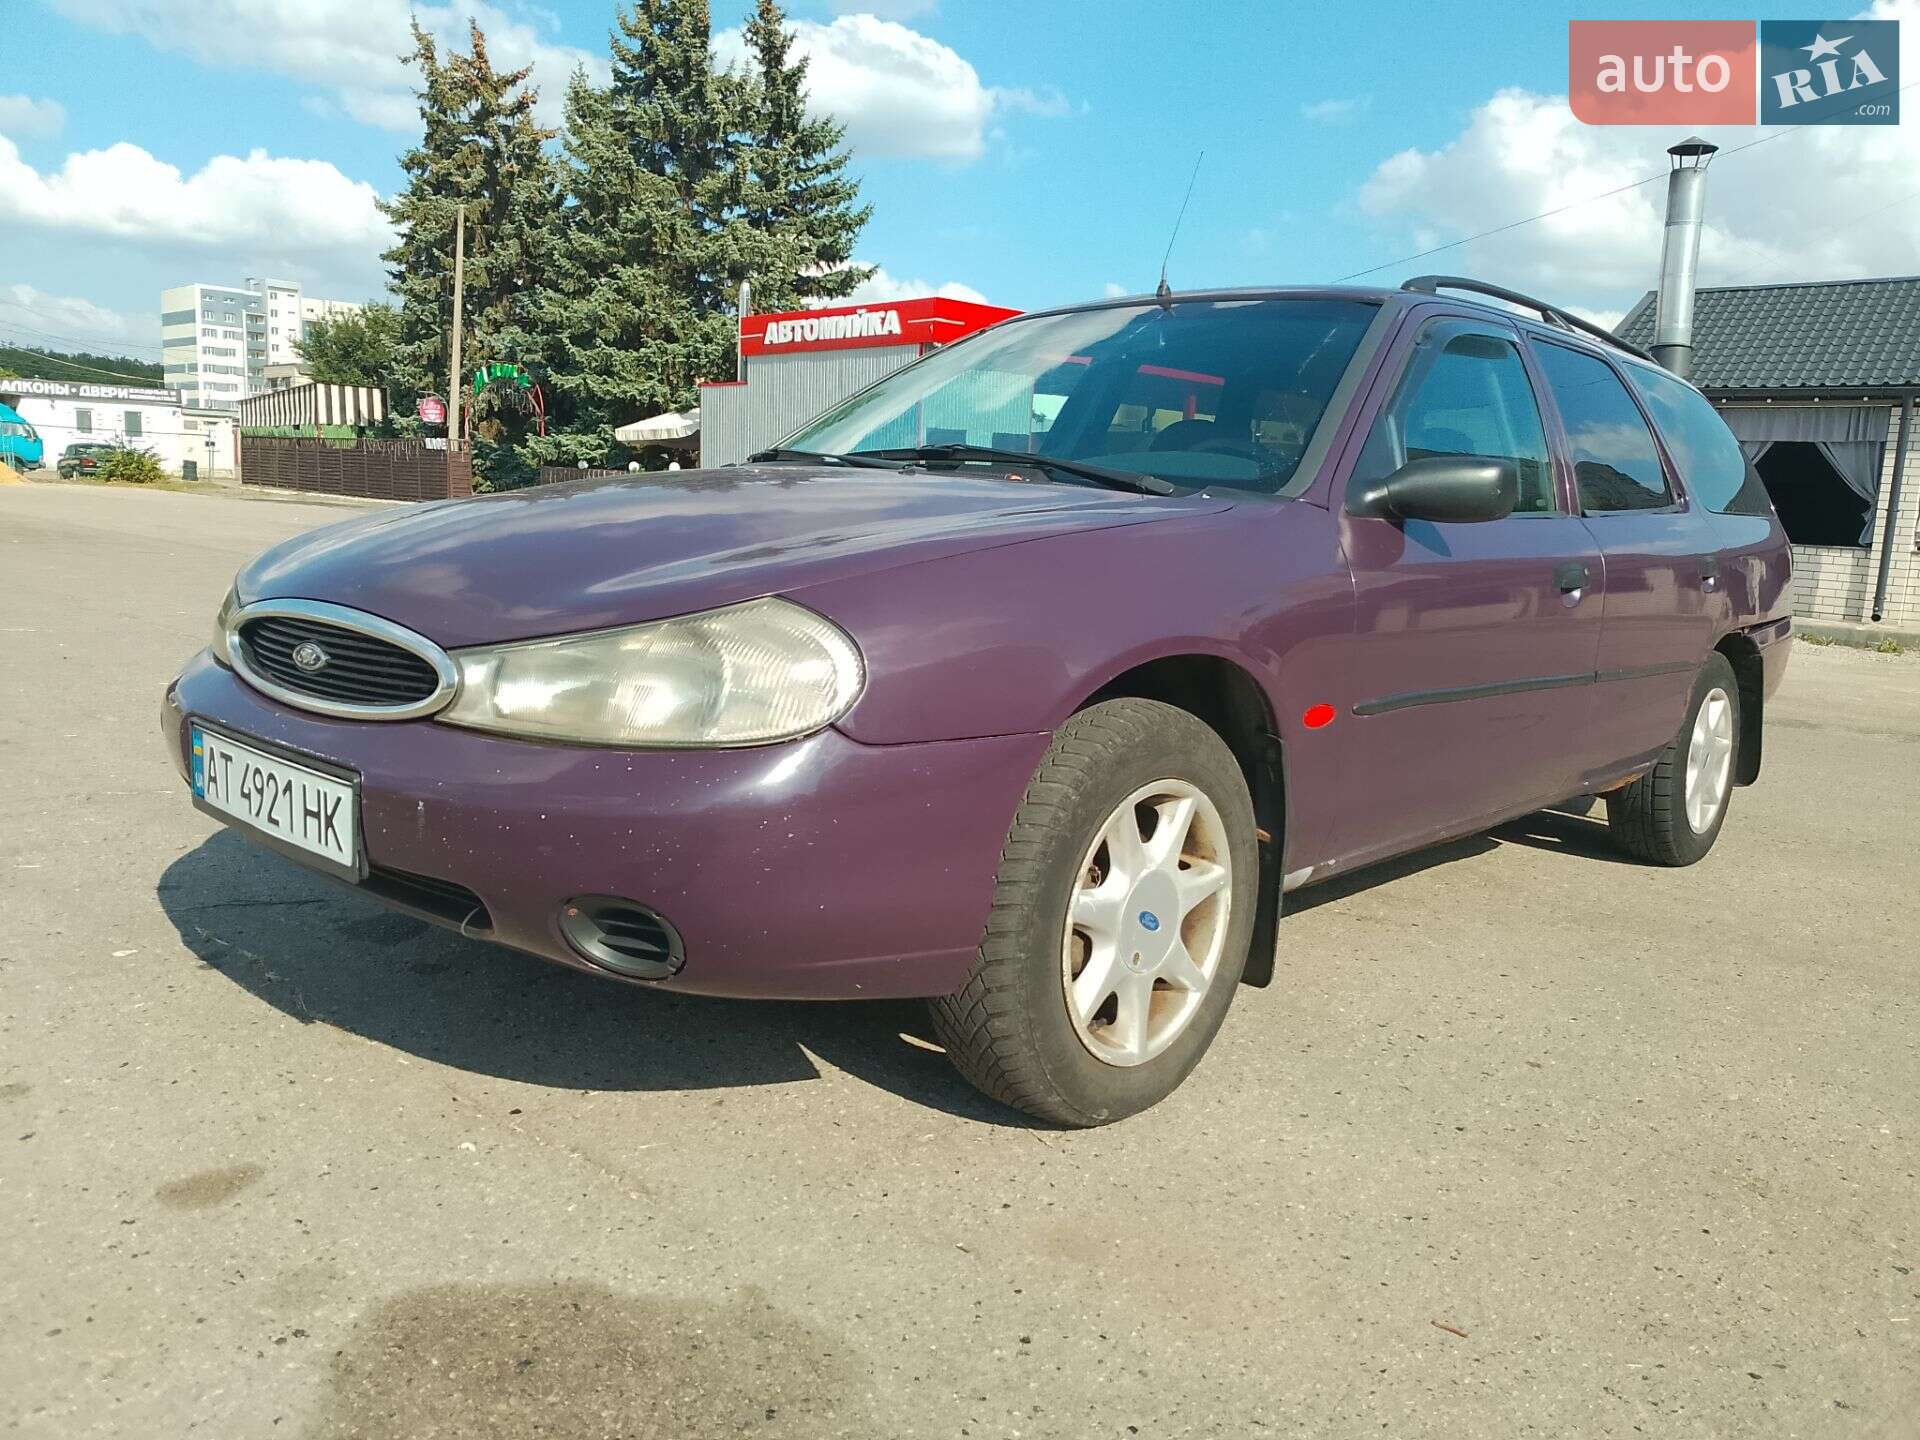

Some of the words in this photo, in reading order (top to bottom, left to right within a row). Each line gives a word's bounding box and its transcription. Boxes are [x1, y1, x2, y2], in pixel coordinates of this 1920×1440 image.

[763, 309, 902, 345] АВТОМИЙКА
[79, 385, 129, 399] ДВЕРИ
[207, 746, 233, 804] AT
[240, 762, 294, 834] 4921
[302, 783, 343, 853] HK
